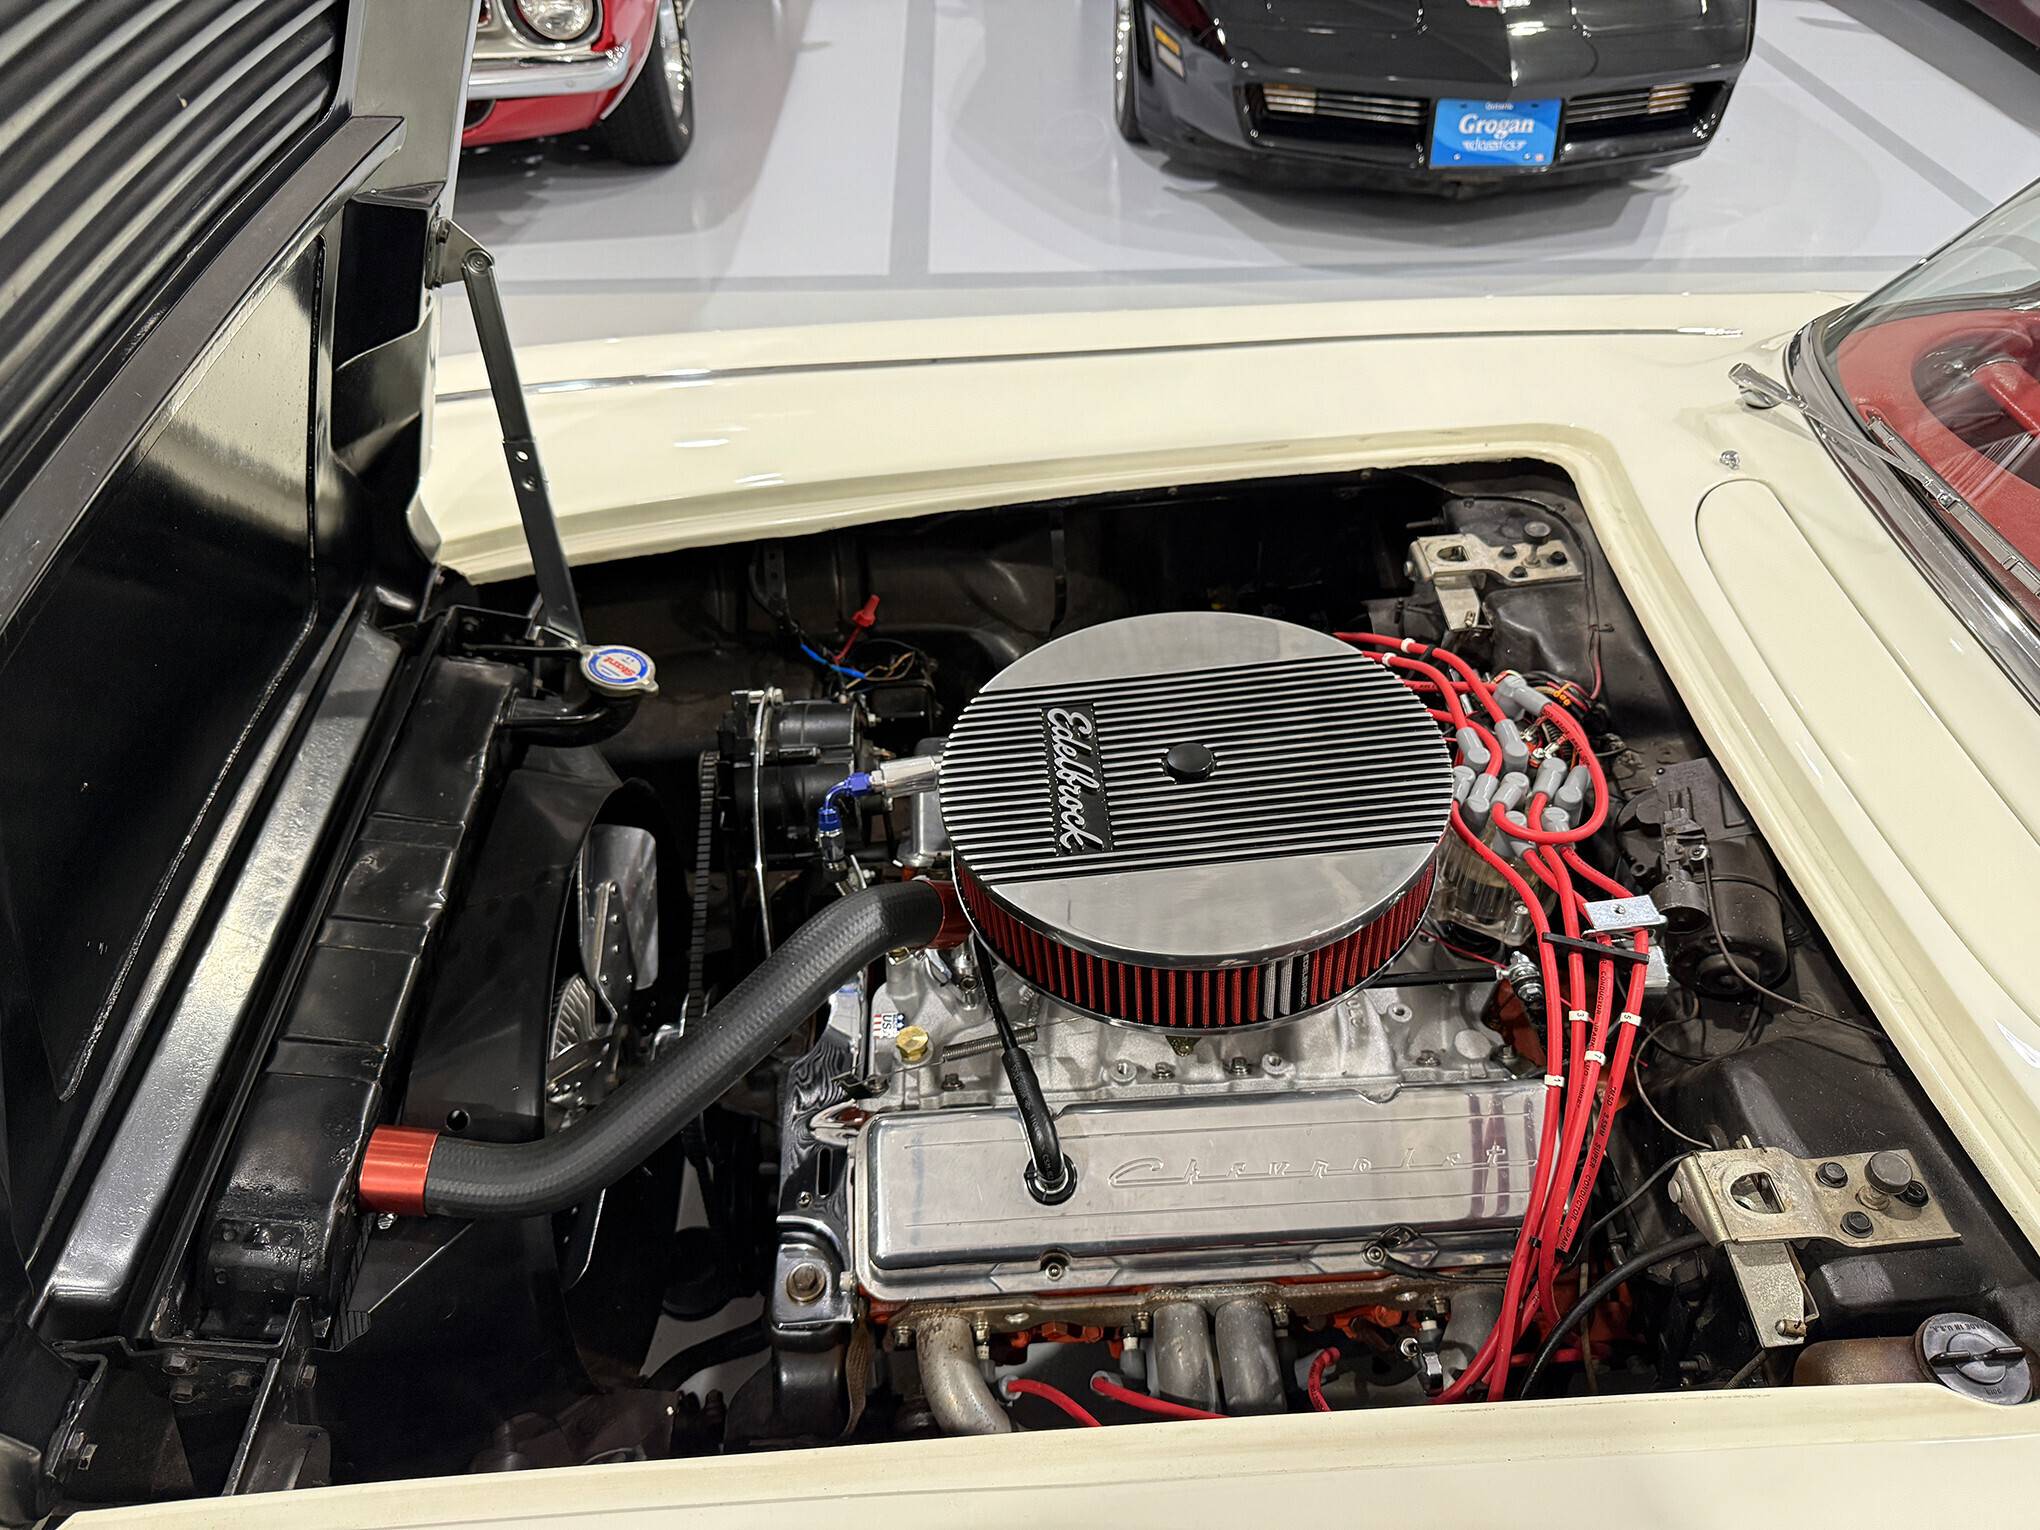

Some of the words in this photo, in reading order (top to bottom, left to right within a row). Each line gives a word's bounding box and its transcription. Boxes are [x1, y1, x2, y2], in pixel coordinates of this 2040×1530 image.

[1458, 113, 1535, 140] Grogan
[1047, 707, 1104, 852] Edelbrock
[1107, 1144, 1538, 1189] Chevrolet
[1589, 1142, 1602, 1169] SUPER
[1570, 1174, 1593, 1222] CONDUCTOR
